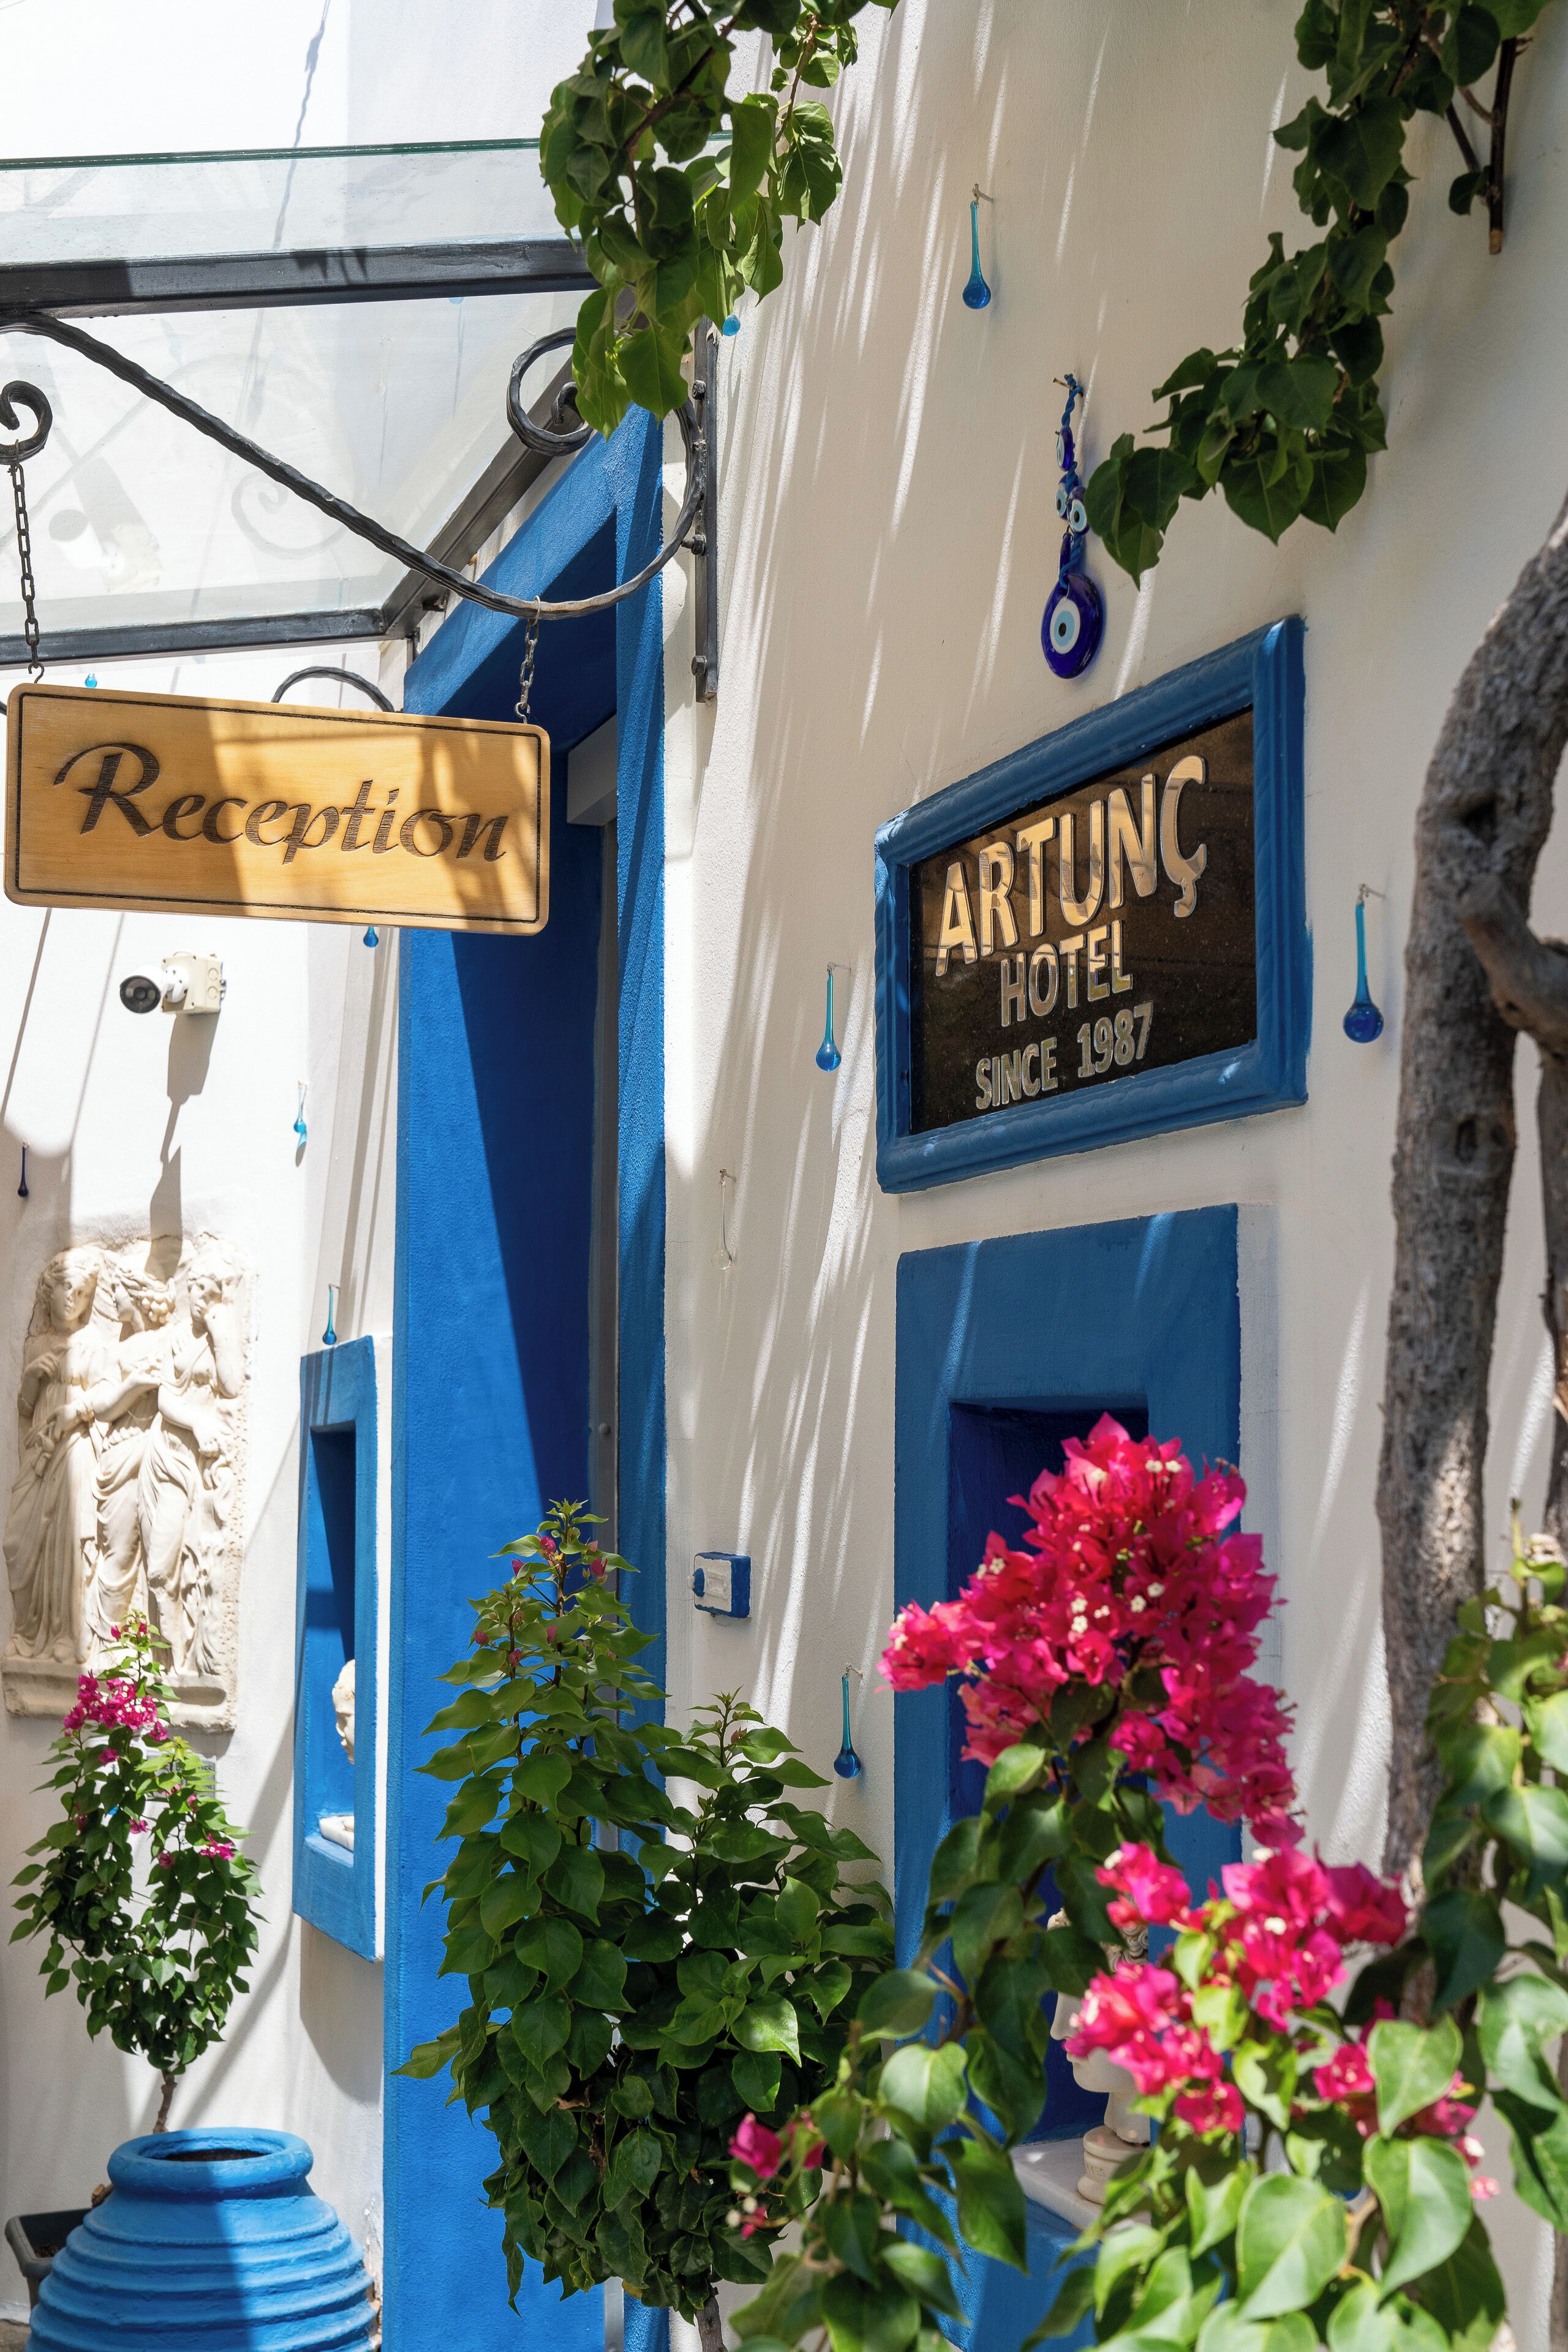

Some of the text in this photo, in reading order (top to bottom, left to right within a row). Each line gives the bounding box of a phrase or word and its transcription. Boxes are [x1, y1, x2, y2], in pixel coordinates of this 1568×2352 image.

[54, 743, 508, 865] Reception
[935, 755, 1207, 977] ARTUNÇ
[1000, 919, 1134, 1028] HOTEL
[975, 1001, 1154, 1110] SINCE 1987
